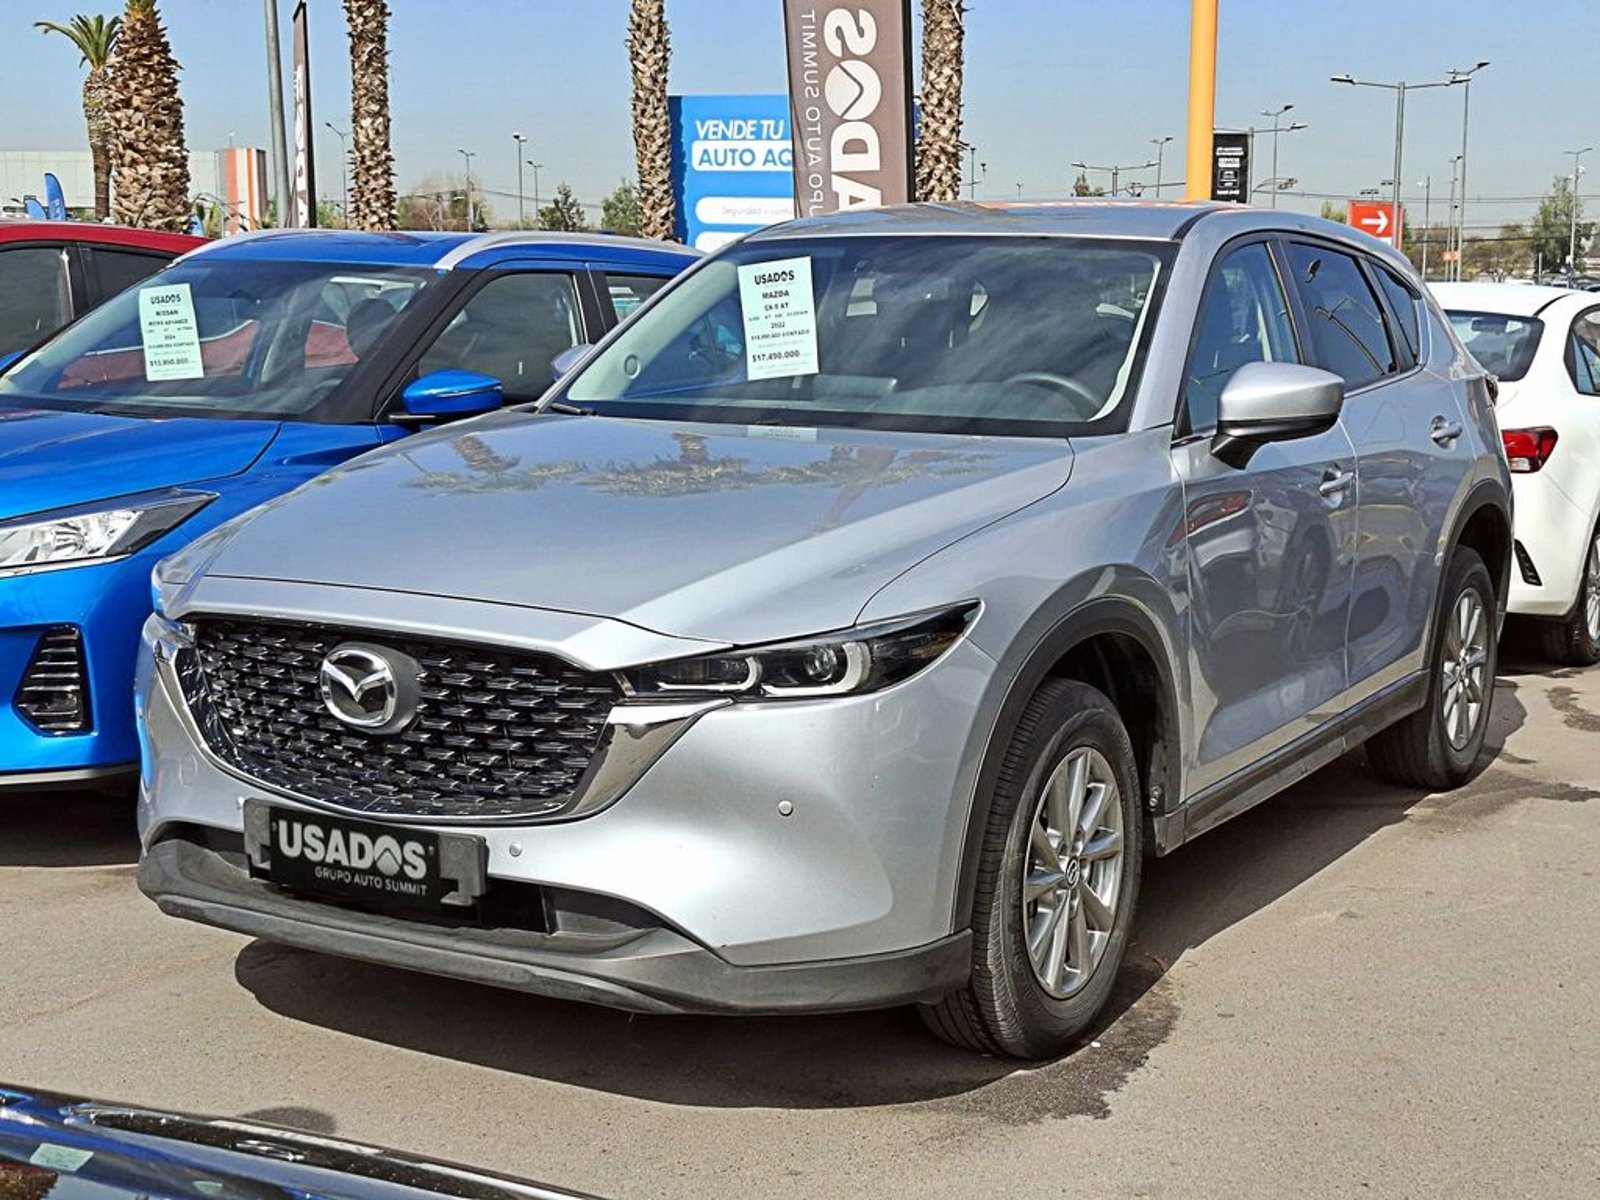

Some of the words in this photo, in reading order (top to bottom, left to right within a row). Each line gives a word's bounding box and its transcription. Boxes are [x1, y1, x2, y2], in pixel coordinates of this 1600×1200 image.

[695, 119, 757, 139] VENDE
[759, 119, 784, 139] TU
[698, 148, 756, 167] AUTO
[754, 270, 795, 285] USADOS
[150, 294, 182, 305] USADOS
[762, 290, 789, 299] MAZDA
[277, 820, 428, 880] USADOS
[315, 865, 352, 884] GRUPO
[353, 874, 383, 890] AUTO
[385, 879, 428, 897] SUMMIT
